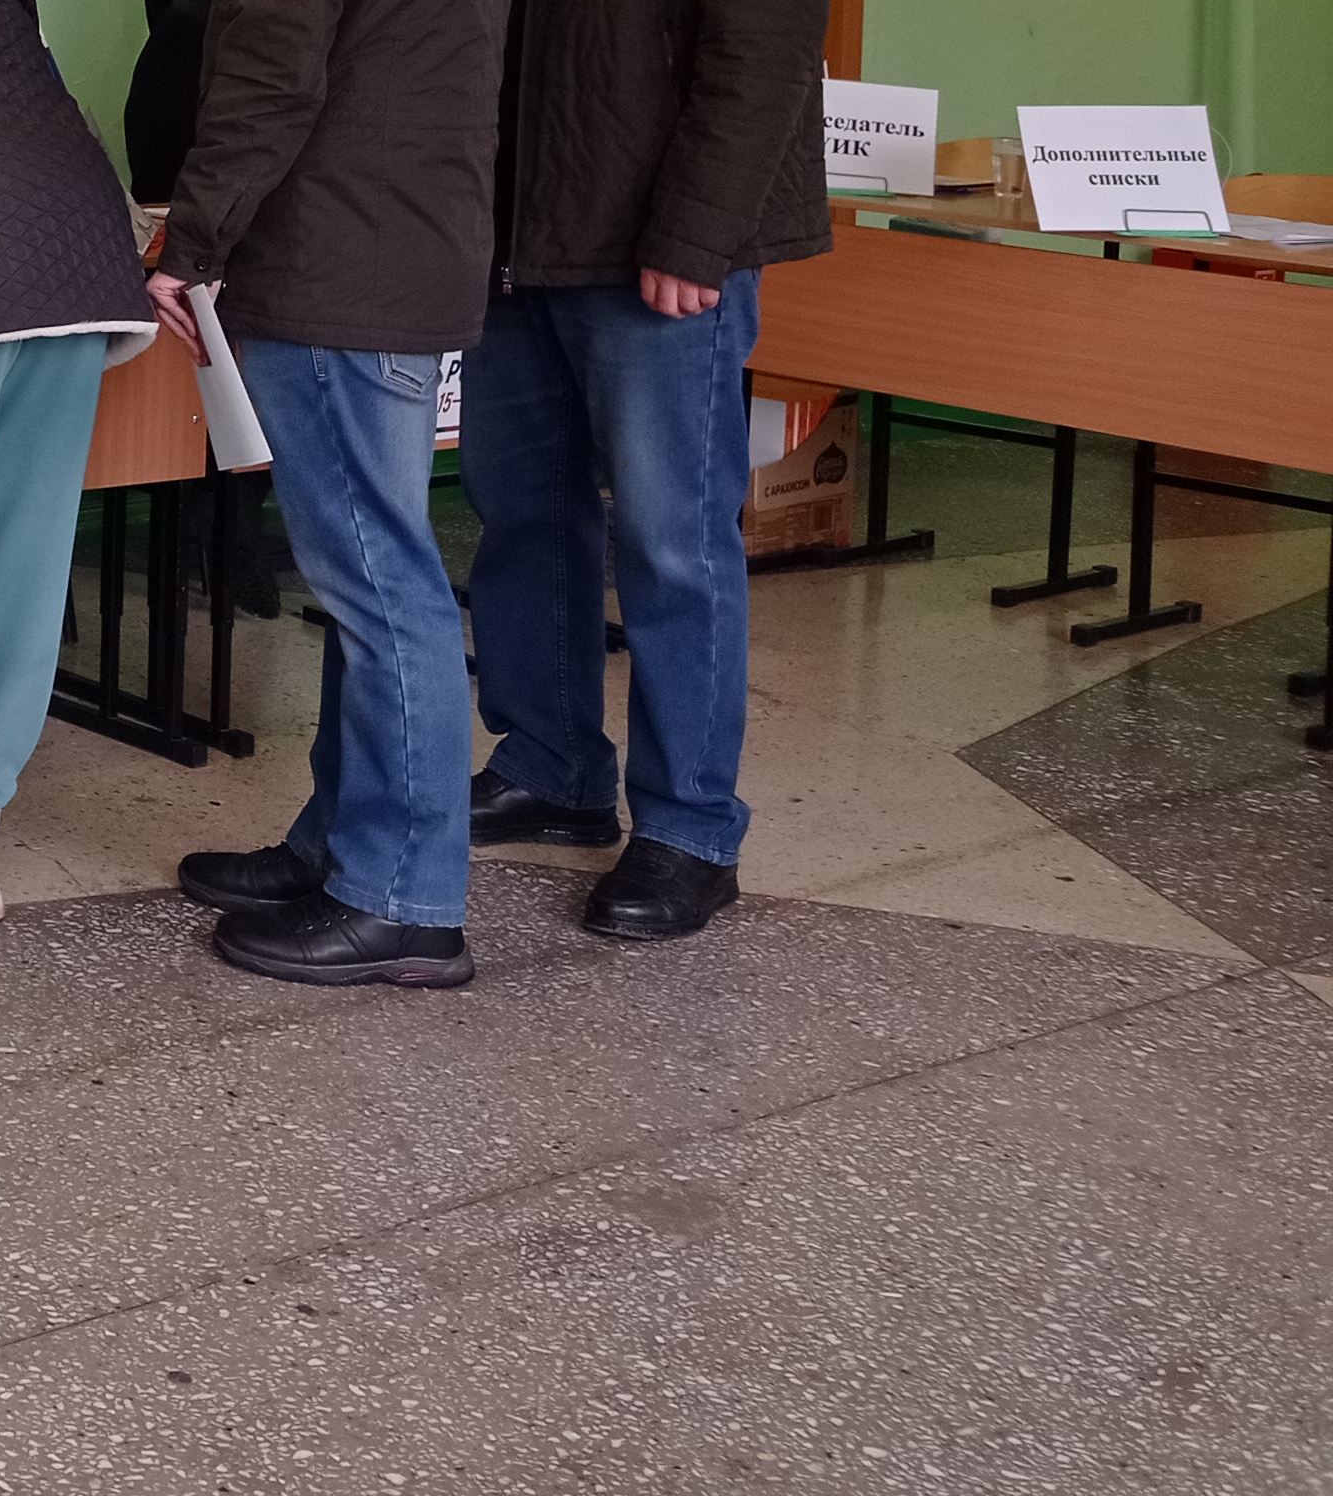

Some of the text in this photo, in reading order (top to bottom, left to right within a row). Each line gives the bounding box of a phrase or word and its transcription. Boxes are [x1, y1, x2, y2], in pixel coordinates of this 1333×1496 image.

[823, 116, 925, 138] седатель
[1032, 145, 1208, 165] Дополнительные
[1088, 173, 1161, 186] списки
[437, 391, 462, 413] 15-
[770, 478, 811, 495] АРАХИСОМ
